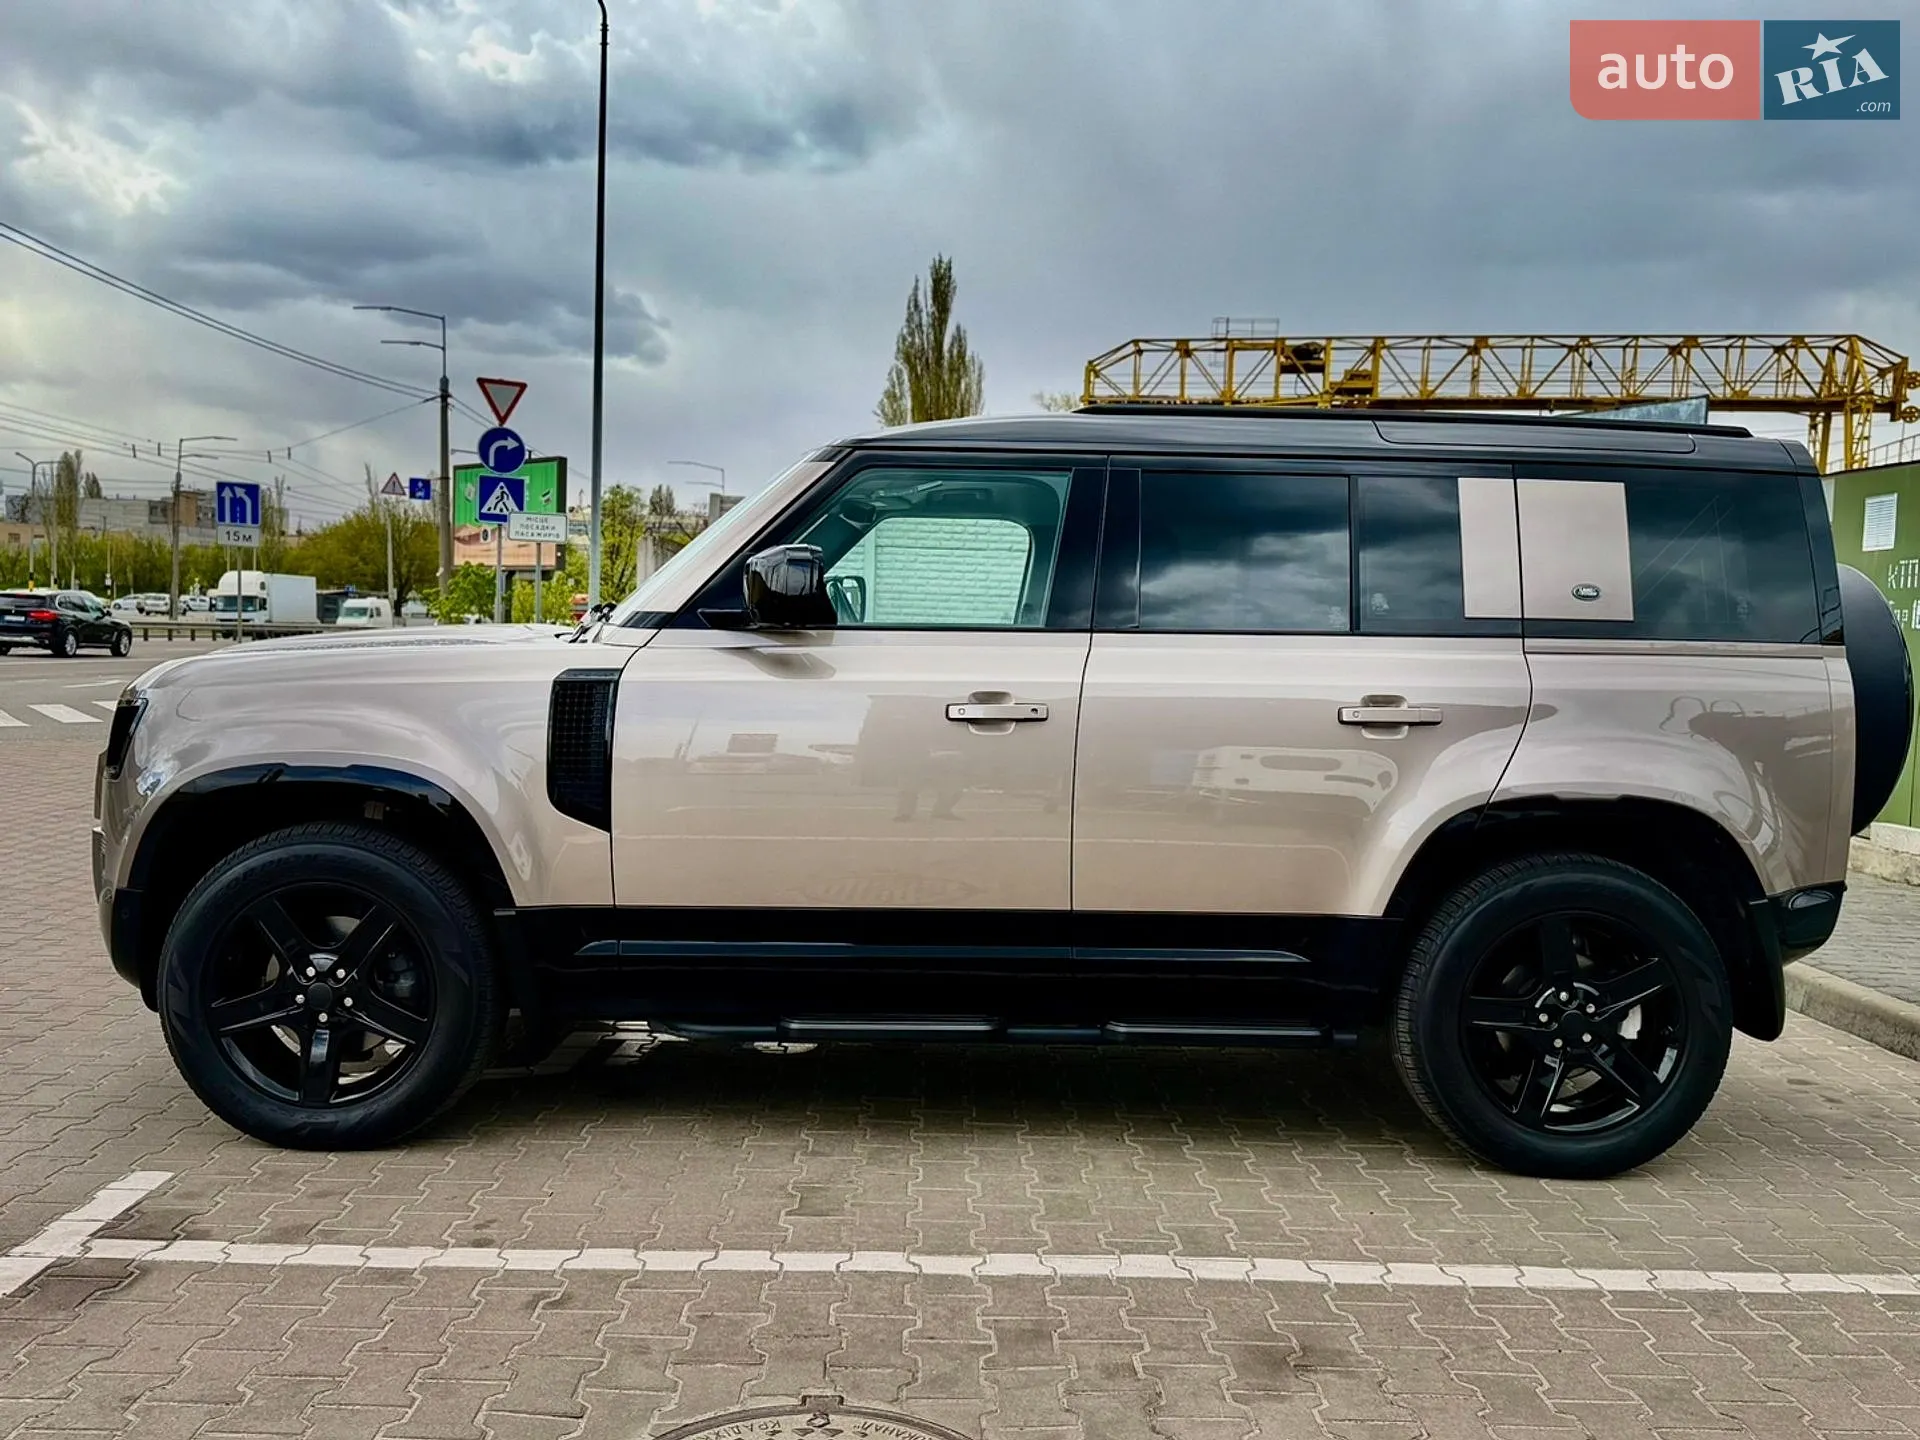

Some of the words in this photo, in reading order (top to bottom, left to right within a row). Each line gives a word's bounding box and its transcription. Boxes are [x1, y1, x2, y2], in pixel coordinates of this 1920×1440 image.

[520, 523, 556, 531] ПОСАДКИ
[226, 531, 240, 541] 15
[1888, 559, 1919, 590] КТП
